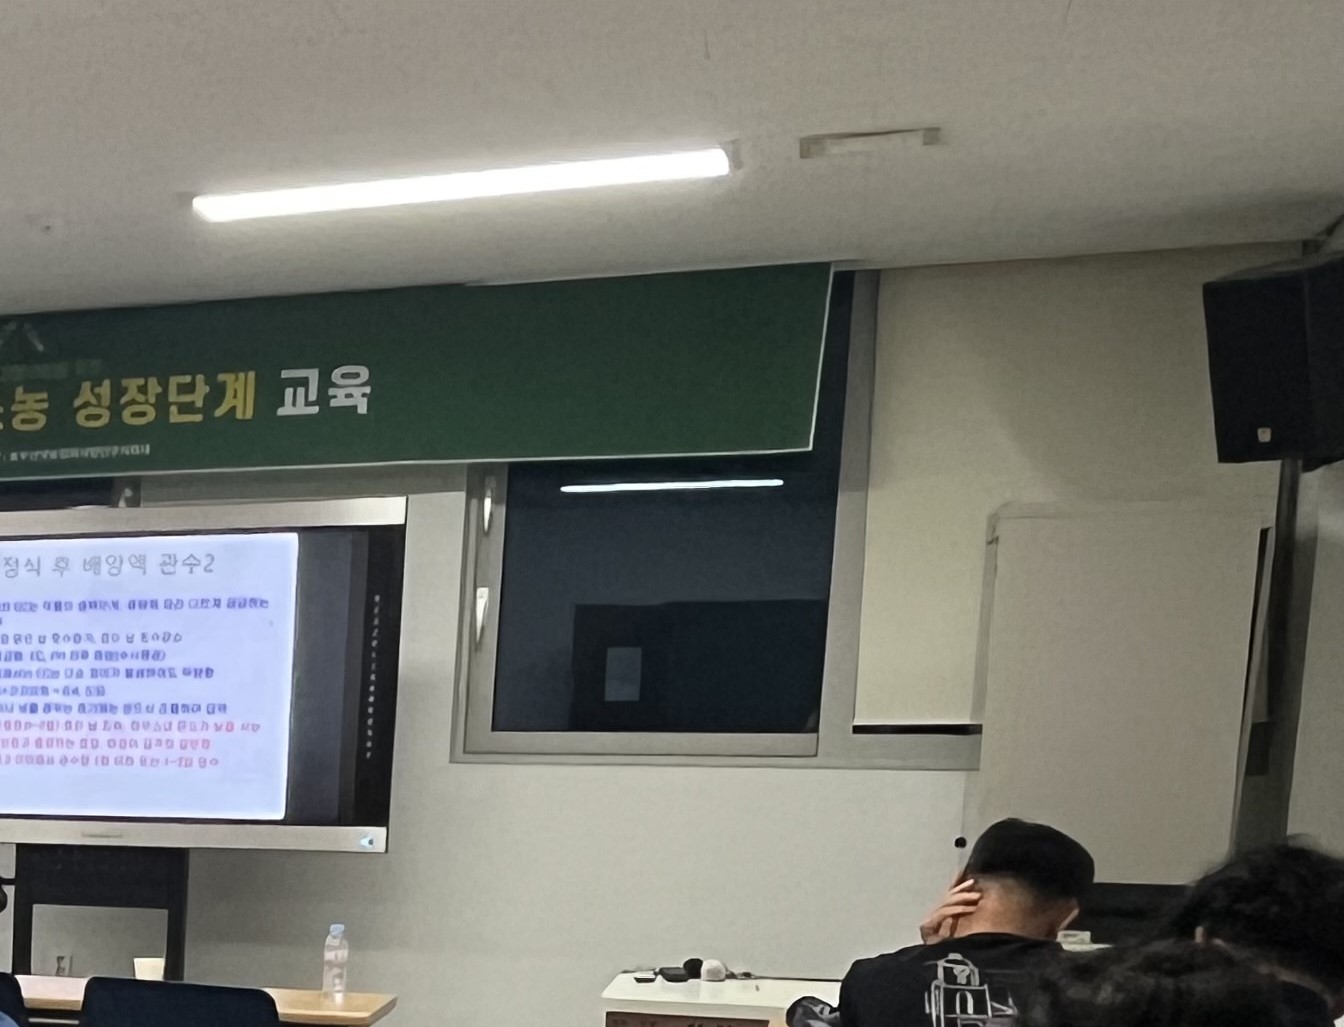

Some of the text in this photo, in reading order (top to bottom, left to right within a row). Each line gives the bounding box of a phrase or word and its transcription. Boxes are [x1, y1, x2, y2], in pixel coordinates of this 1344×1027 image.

[72, 370, 257, 428] 성장단계
[276, 364, 372, 417] 교육
[3, 552, 216, 579] 정식 후 배양액 관수2
